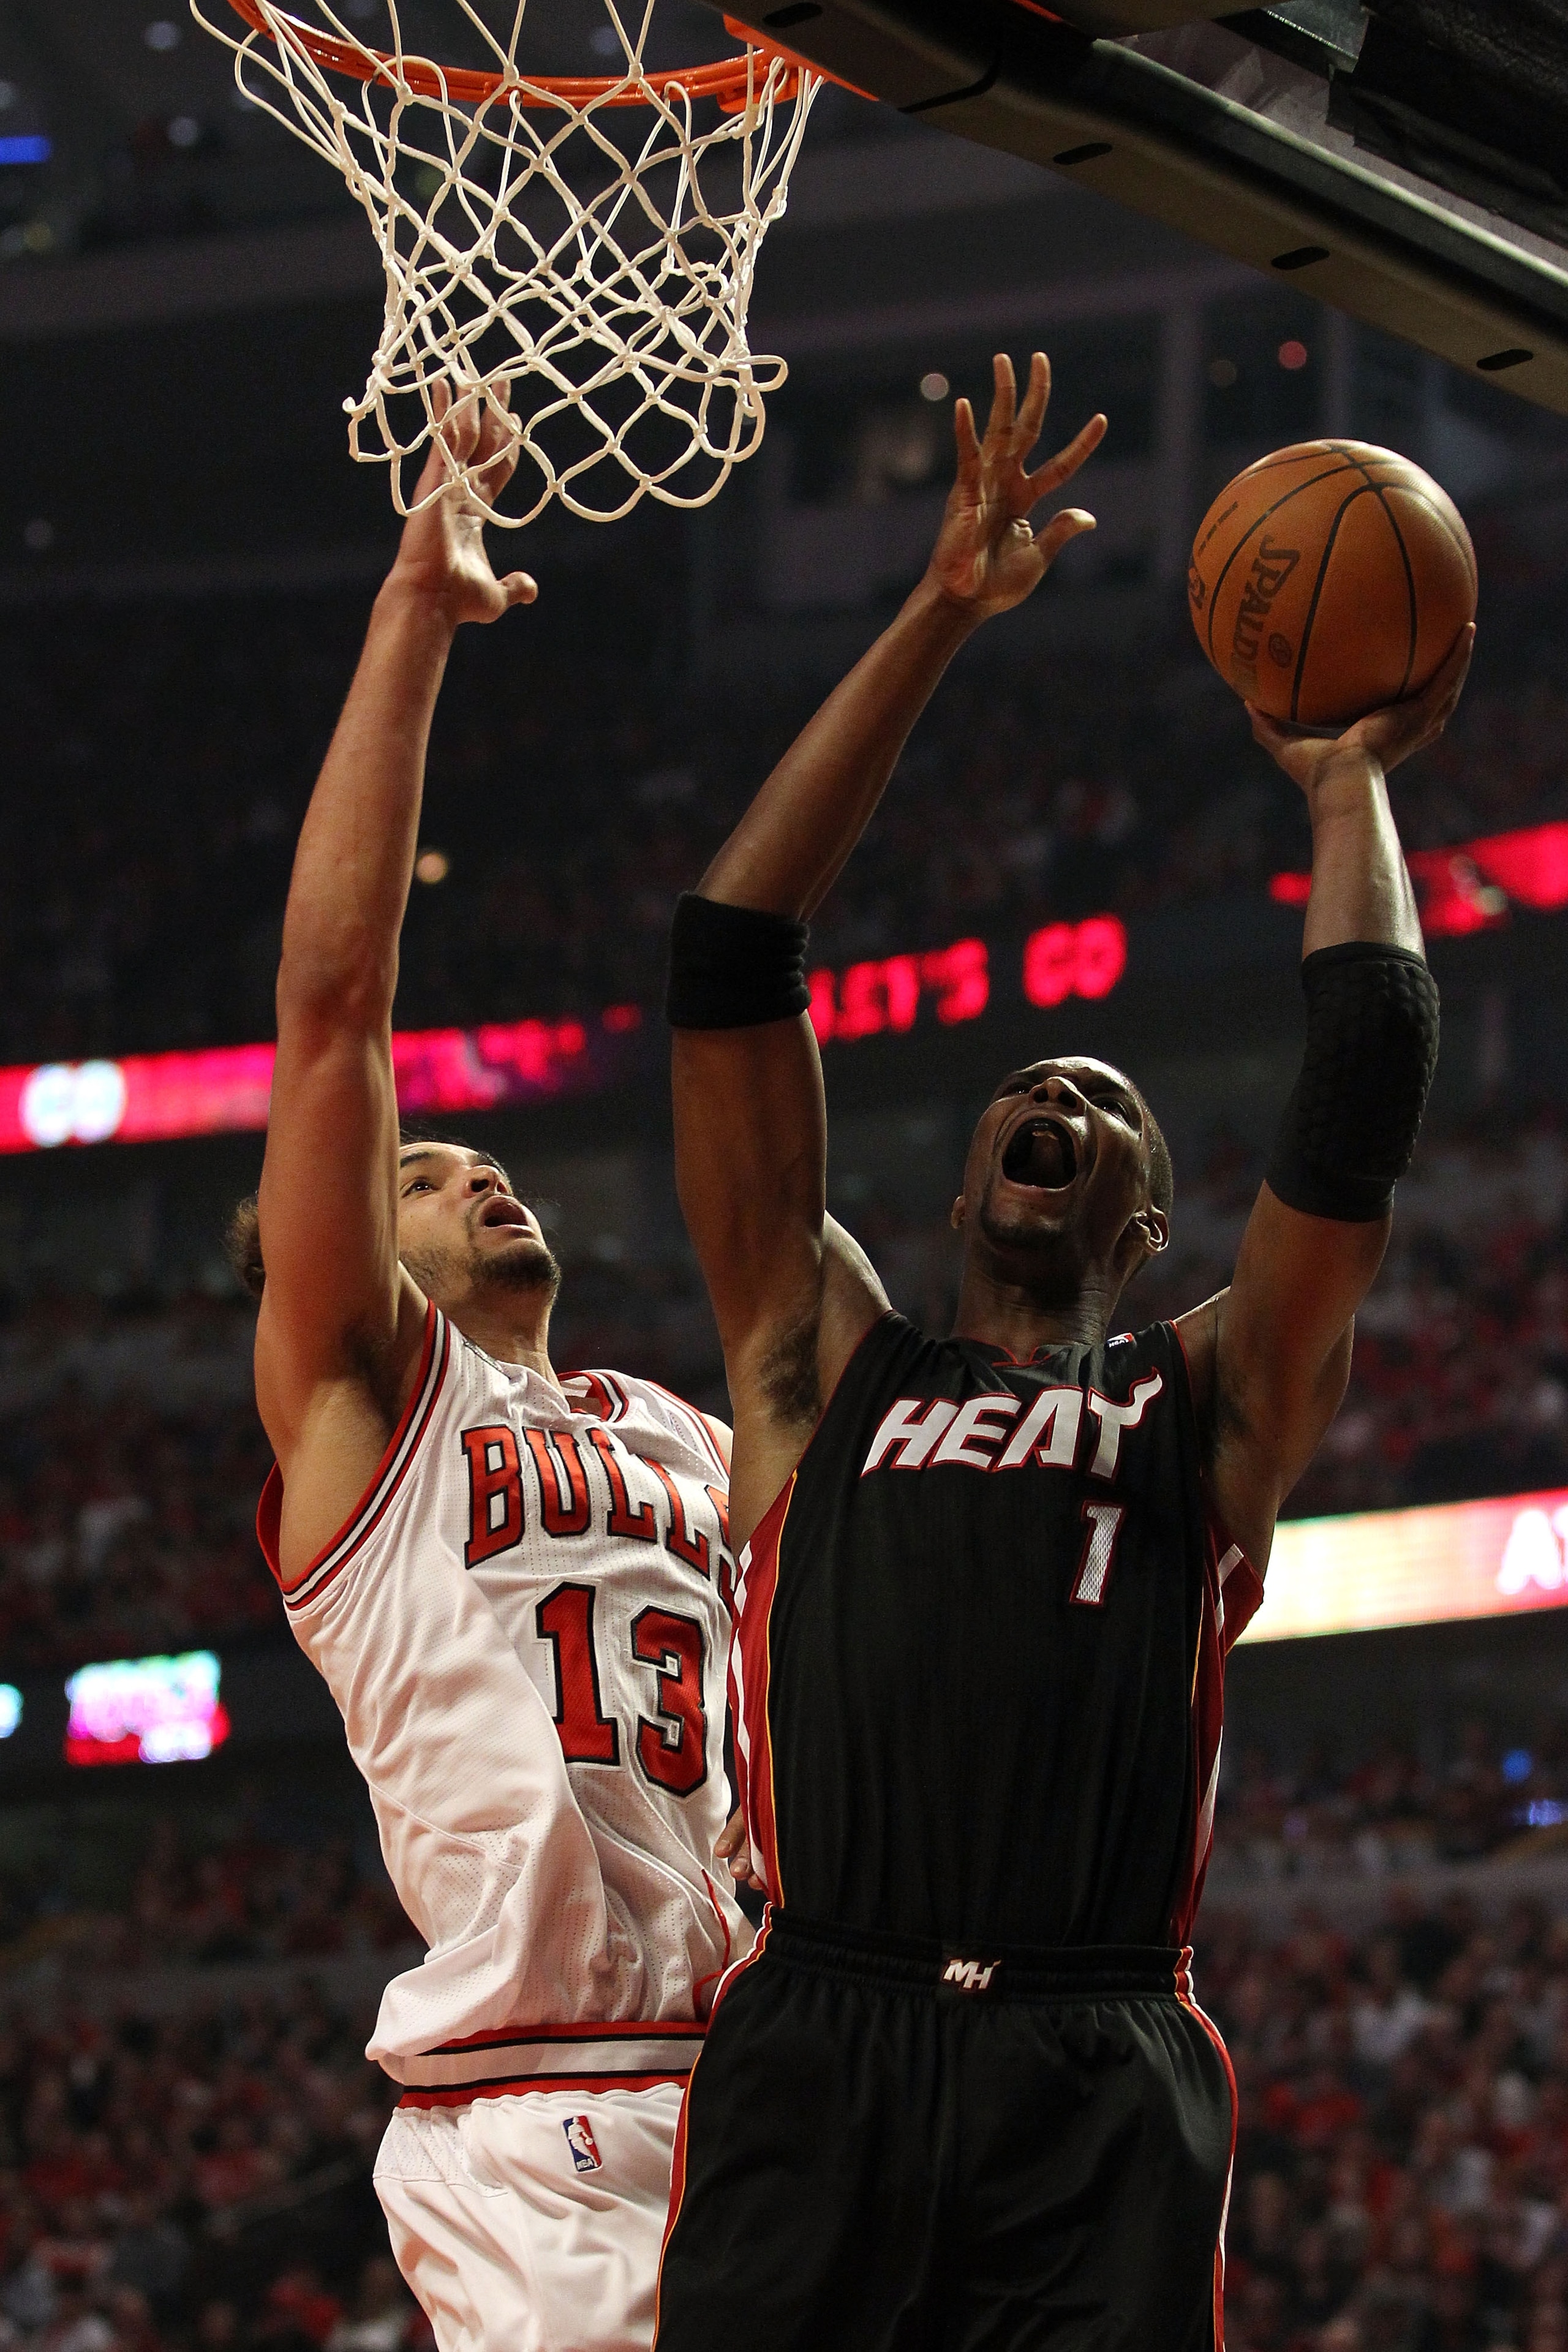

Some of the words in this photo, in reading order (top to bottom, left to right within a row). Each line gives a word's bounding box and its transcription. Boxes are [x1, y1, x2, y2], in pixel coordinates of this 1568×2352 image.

[859, 1366, 1165, 1484] HEAT
[1069, 1499, 1125, 1607] 1
[535, 1580, 709, 1798] 13
[942, 1958, 1003, 1990] MH
